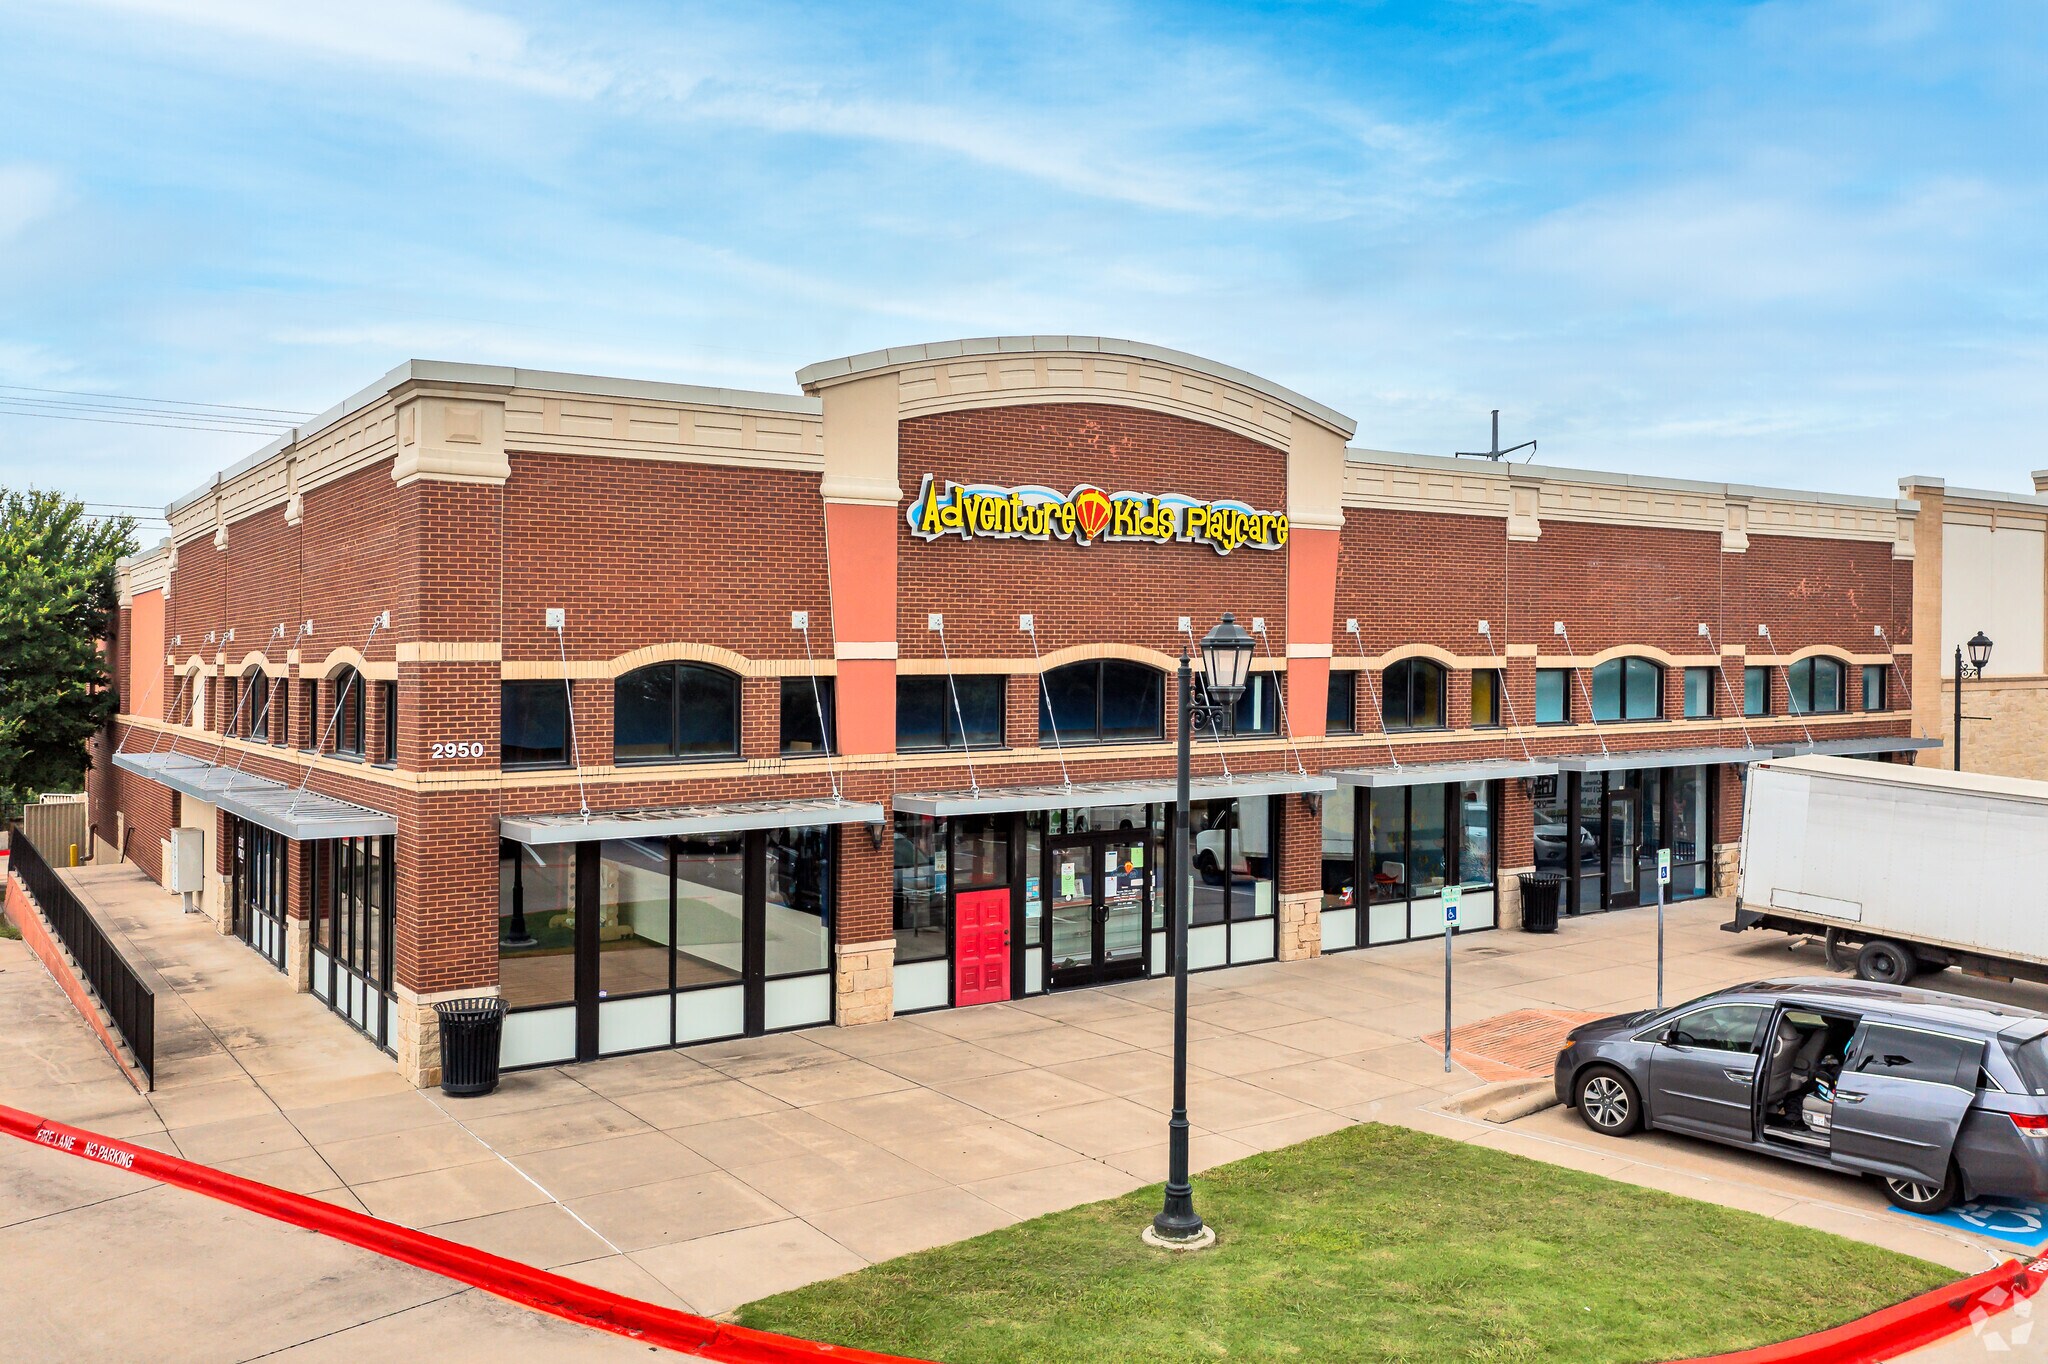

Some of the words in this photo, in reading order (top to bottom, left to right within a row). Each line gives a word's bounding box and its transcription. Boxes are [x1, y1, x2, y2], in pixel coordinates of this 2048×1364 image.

[920, 480, 1076, 536] Adventure
[1112, 498, 1175, 539] Kids
[1185, 504, 1289, 551] Playcare
[431, 742, 484, 759] 2950
[35, 1129, 54, 1144] FIRE
[54, 1133, 77, 1151] LANE
[97, 1145, 135, 1168] PARKING
